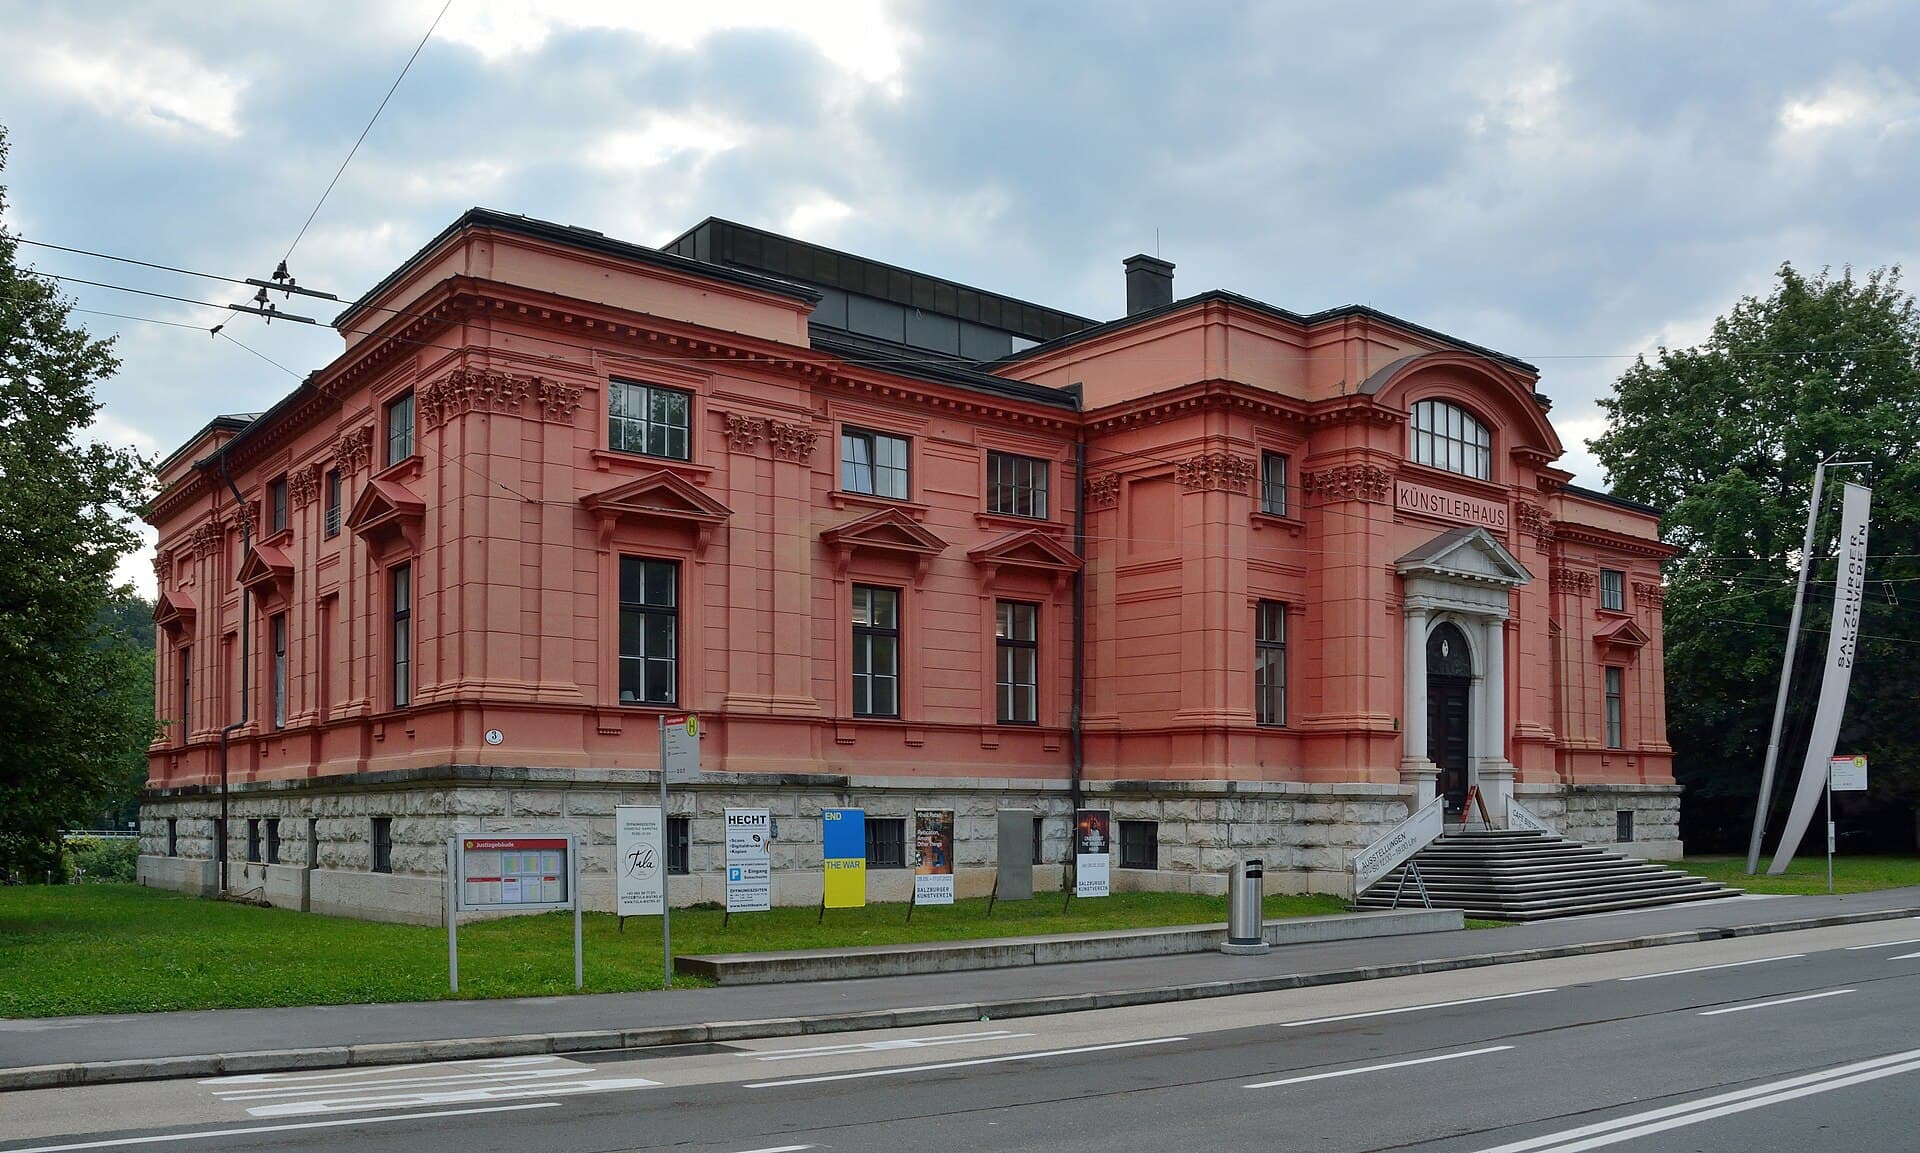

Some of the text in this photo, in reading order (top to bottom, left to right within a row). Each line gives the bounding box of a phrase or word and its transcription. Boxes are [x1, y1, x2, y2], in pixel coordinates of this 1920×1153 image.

[1400, 487, 1505, 526] KÜNSTLERHAUS
[1838, 535, 1857, 668] SALZBURGER
[491, 730, 498, 740] 3
[728, 815, 767, 825] HECHT
[824, 812, 842, 821] END
[1361, 831, 1407, 869] AUSSTELLUNGEN
[624, 849, 657, 878] Tila
[826, 861, 841, 869] THE
